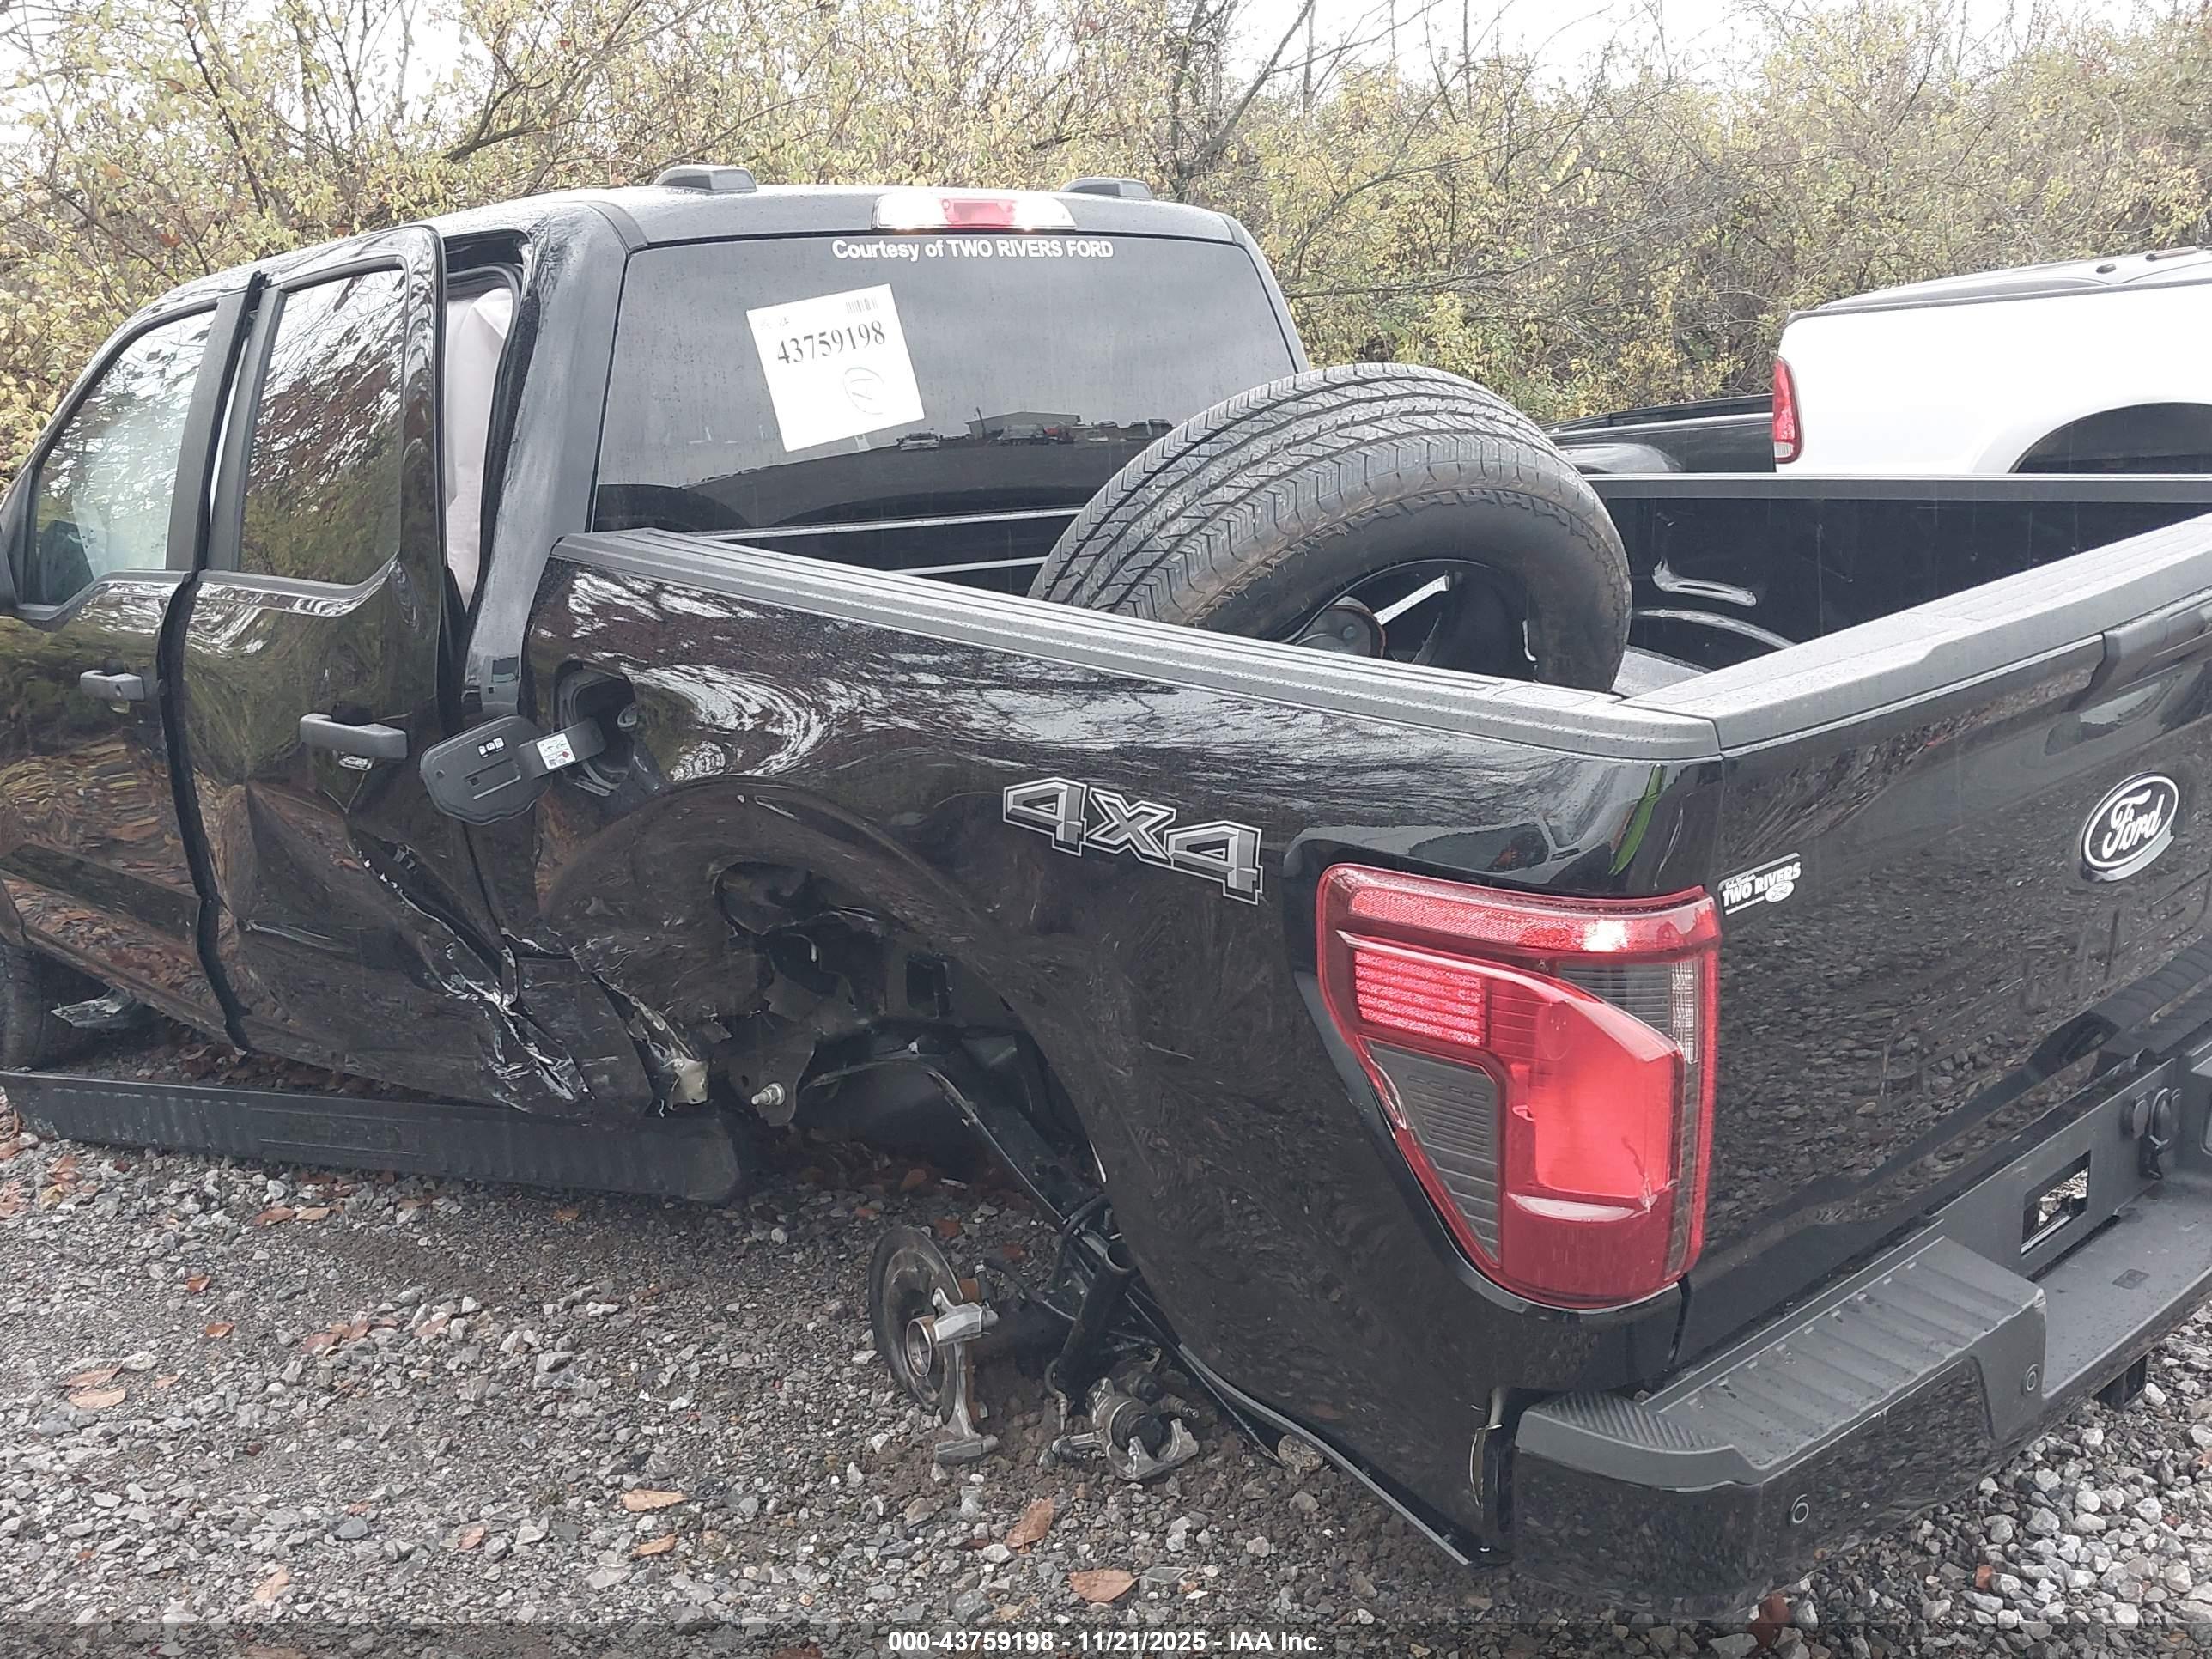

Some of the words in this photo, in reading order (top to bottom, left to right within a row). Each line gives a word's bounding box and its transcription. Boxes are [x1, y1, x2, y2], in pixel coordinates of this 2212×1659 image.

[832, 240, 920, 262] Courtesy
[926, 240, 944, 258] of
[946, 240, 994, 258] TWO
[997, 240, 1064, 258] RIVERS
[1066, 240, 1114, 258] FORD
[777, 320, 886, 364] 43759198
[2101, 788, 2166, 860] Ford
[1722, 882, 1753, 908] TWO
[1754, 861, 1802, 895] RIVERS
[1407, 1075, 1491, 1103] FORD
